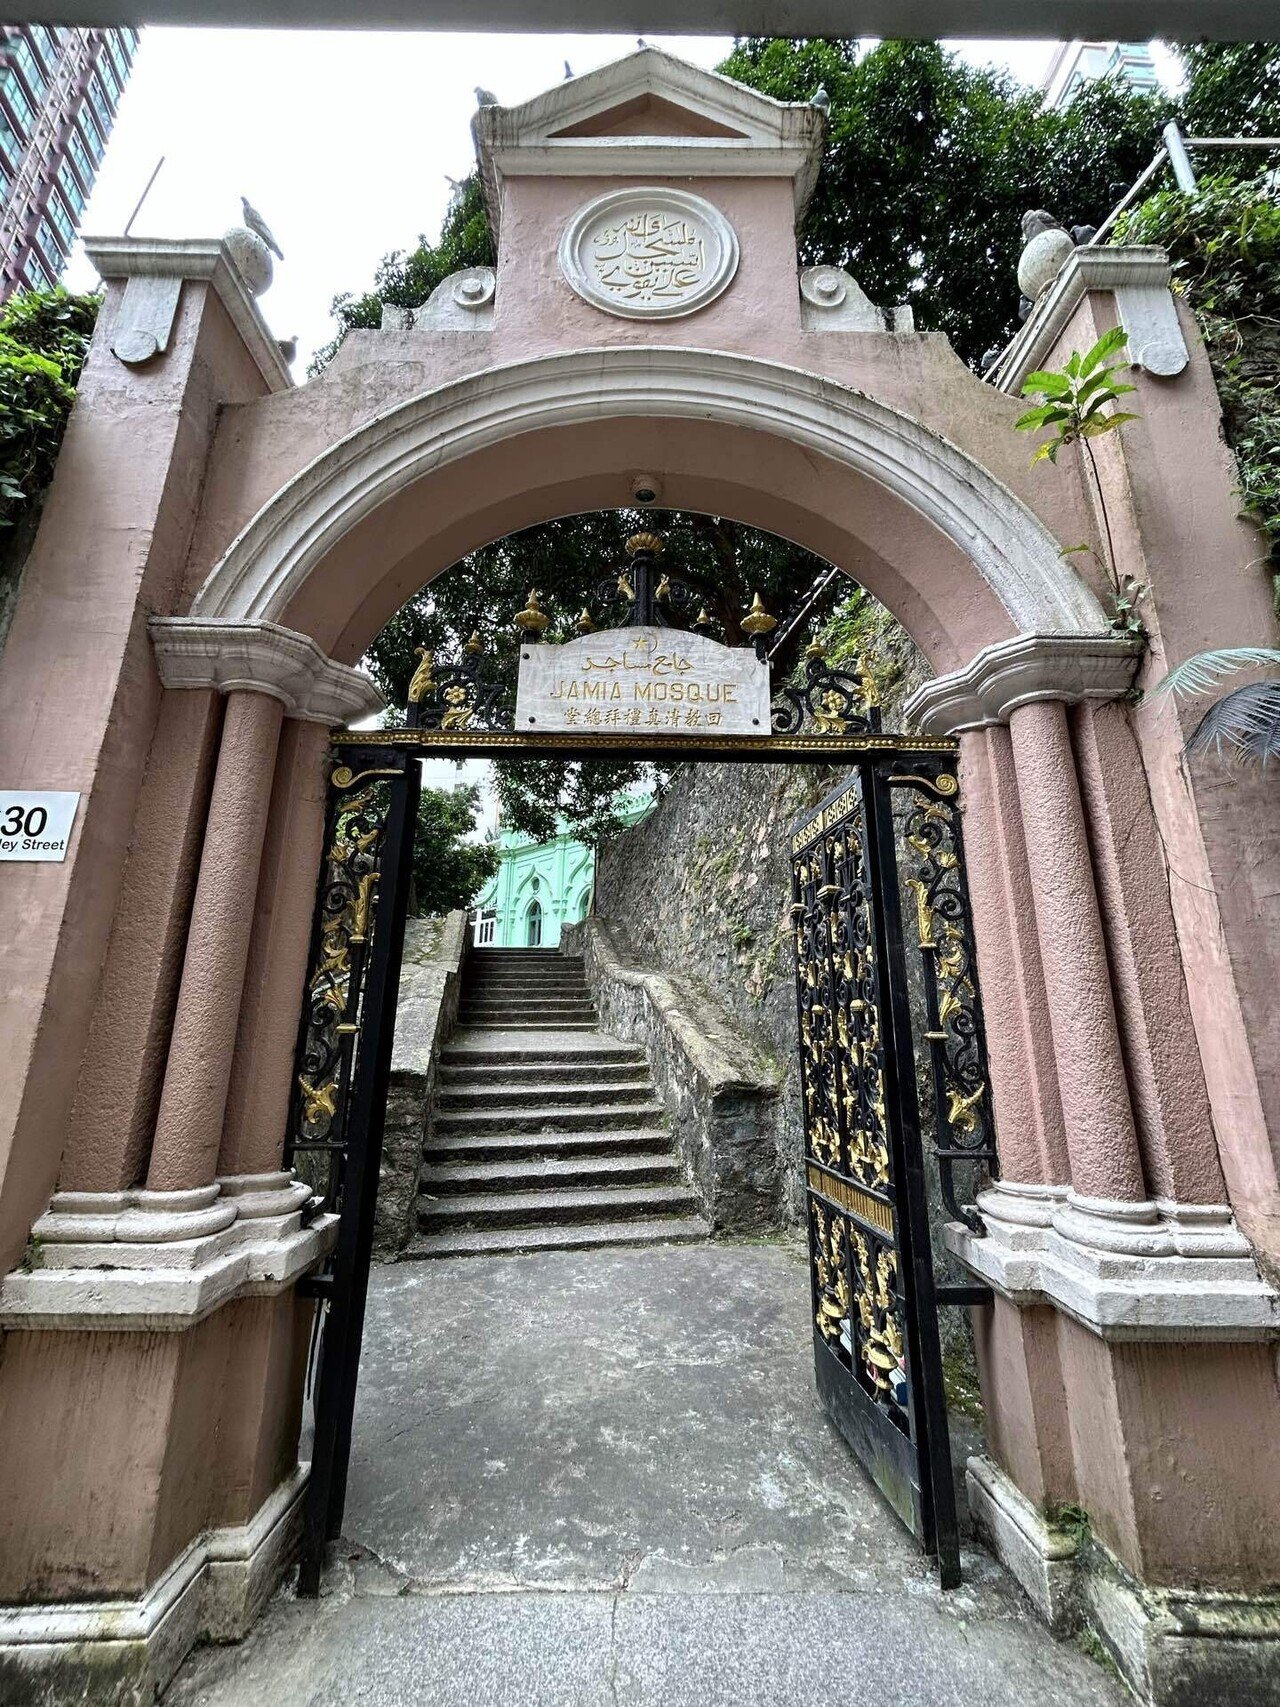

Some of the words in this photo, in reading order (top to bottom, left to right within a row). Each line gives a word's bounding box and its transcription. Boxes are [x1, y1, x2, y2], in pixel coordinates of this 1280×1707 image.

[550, 680, 621, 700] JAMIA
[634, 683, 737, 704] MOSQUE
[0, 806, 48, 837] 30
[22, 839, 64, 850] Street
